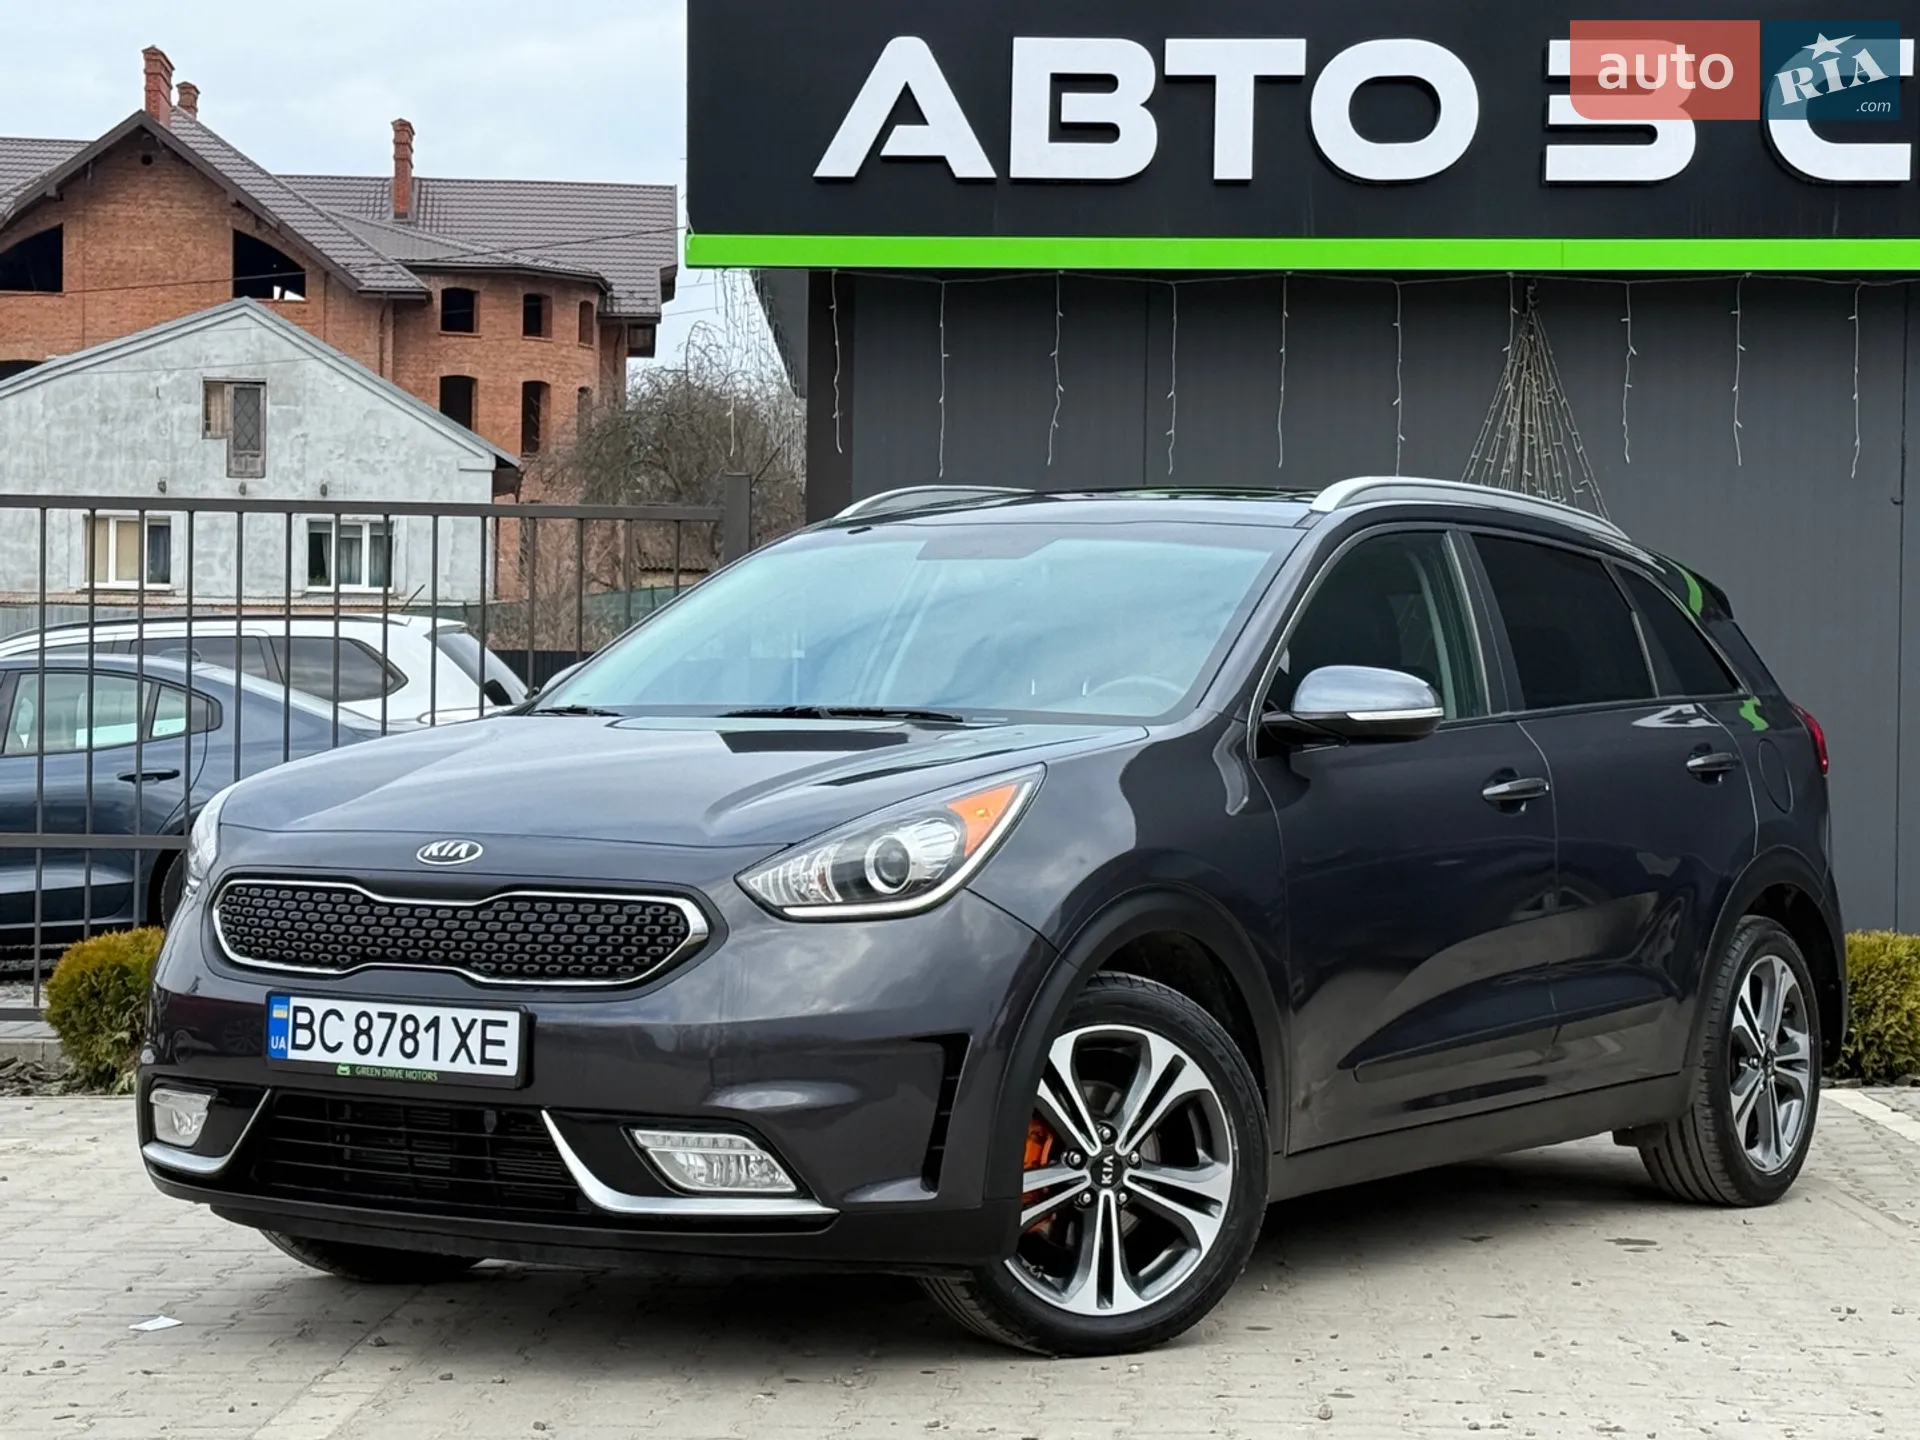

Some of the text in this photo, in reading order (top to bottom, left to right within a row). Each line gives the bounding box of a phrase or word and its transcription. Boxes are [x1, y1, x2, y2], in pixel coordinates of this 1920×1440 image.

[813, 36, 1479, 182] АВТО
[270, 1035, 287, 1051] UA
[353, 1010, 441, 1062] 8781
[355, 1066, 381, 1077] GREEN
[1101, 1155, 1114, 1184] KIA
